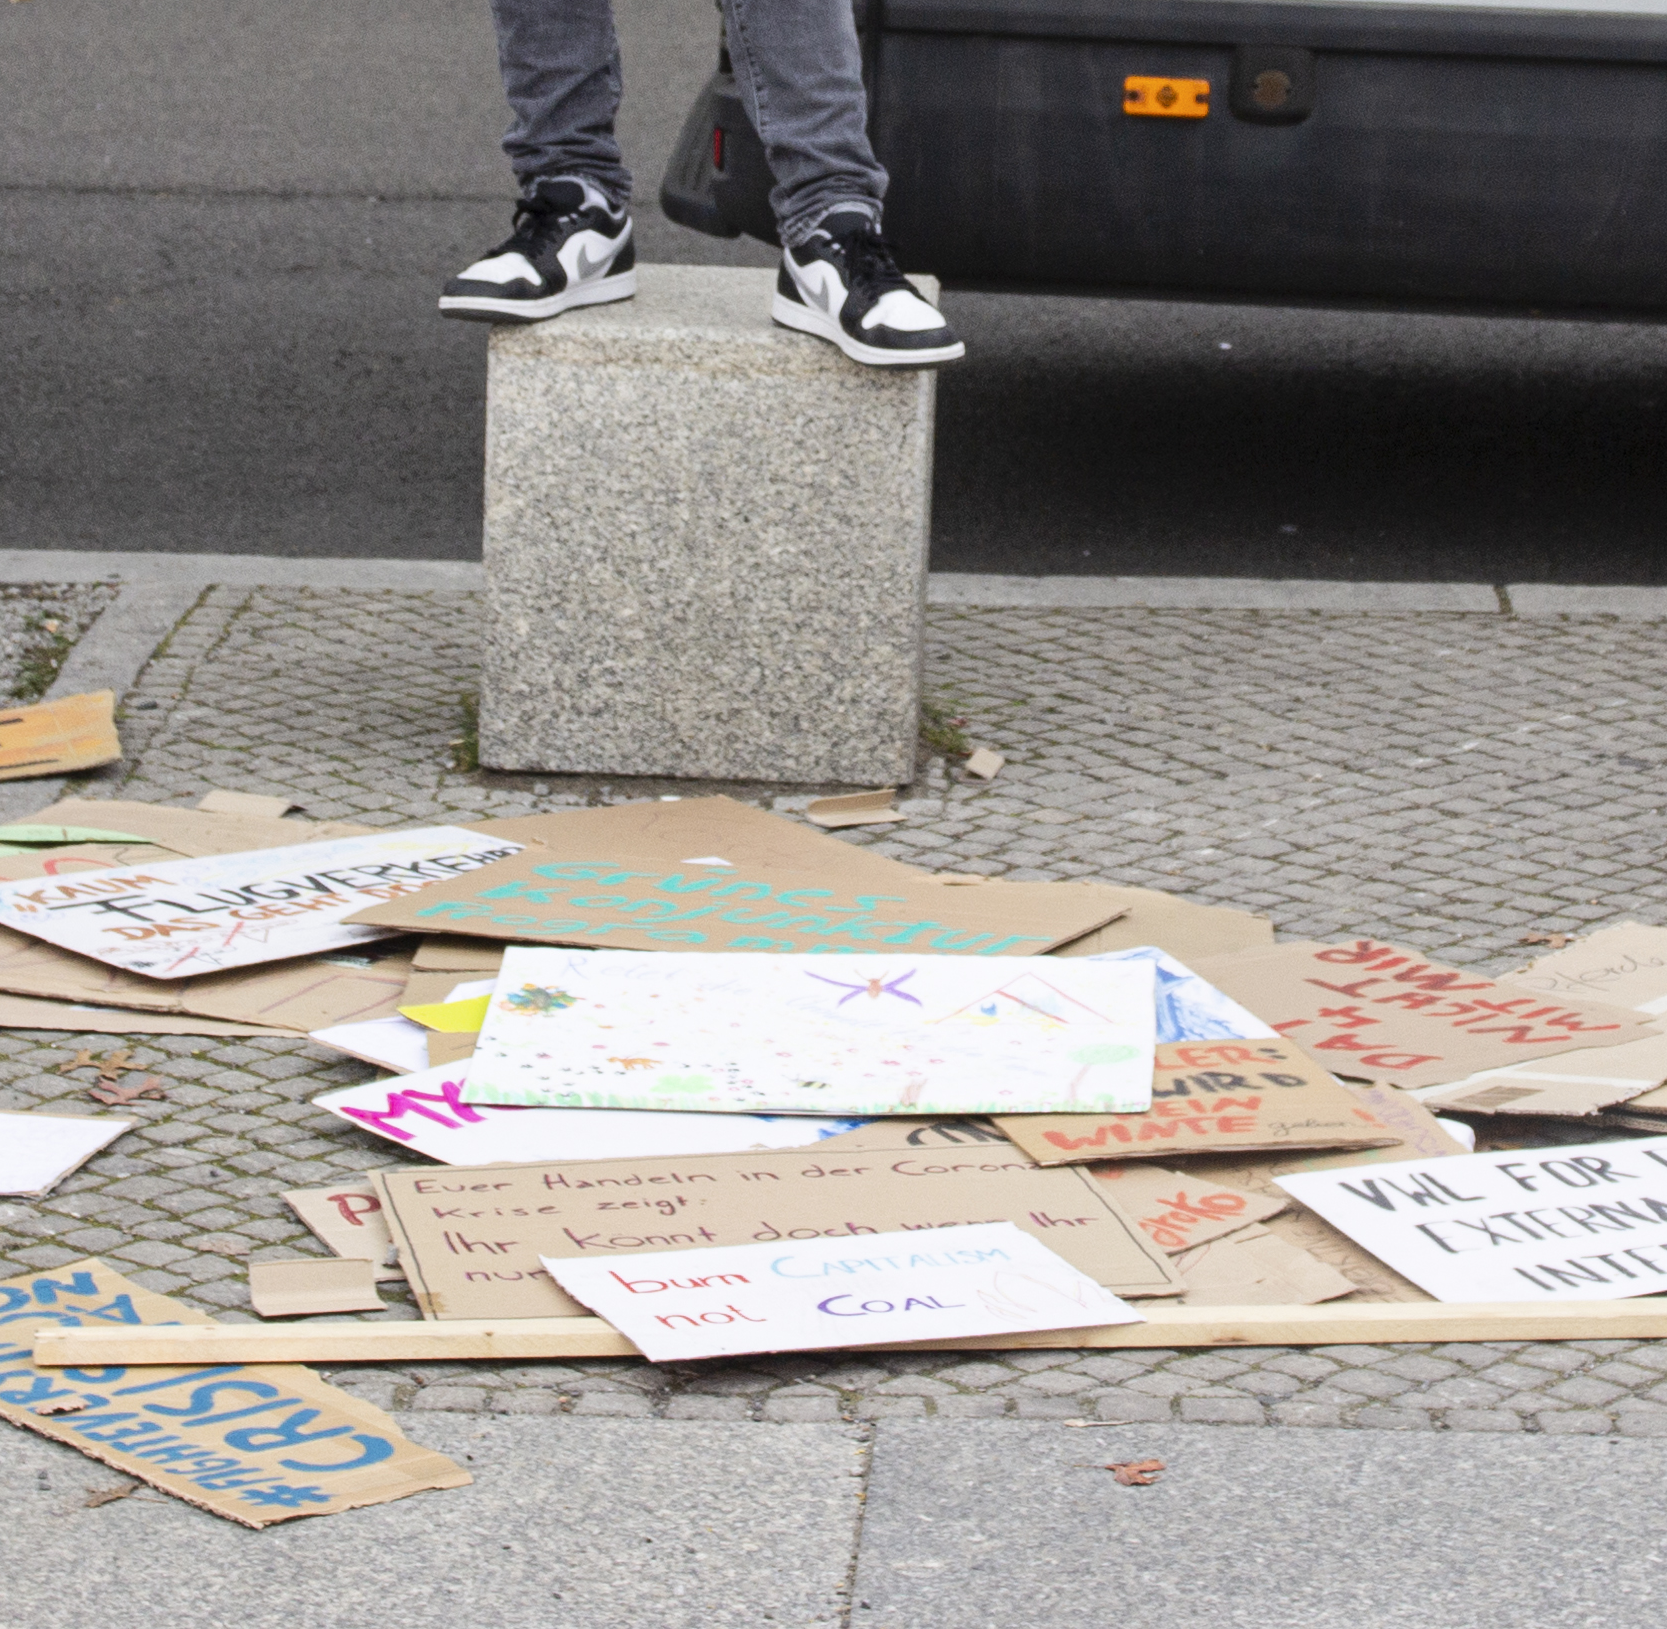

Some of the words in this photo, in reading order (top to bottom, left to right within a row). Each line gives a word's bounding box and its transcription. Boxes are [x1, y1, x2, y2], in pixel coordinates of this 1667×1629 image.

[101, 917, 222, 941] DAS
[228, 892, 351, 921] GEHT
[1302, 977, 1573, 1044] NICHT
[413, 1178, 513, 1194] Euer
[542, 1172, 717, 1191] Handeln
[738, 1169, 780, 1182] in
[800, 1164, 872, 1179] der
[1338, 1170, 1488, 1213] VWL
[1505, 1153, 1618, 1193] FOR
[442, 1230, 520, 1255] Ihr
[752, 1221, 880, 1242] doch
[1028, 1211, 1099, 1229] Ihr
[769, 1247, 1013, 1279] CAPITALISM
[654, 1304, 768, 1331] not
[816, 1293, 966, 1317] COAL
